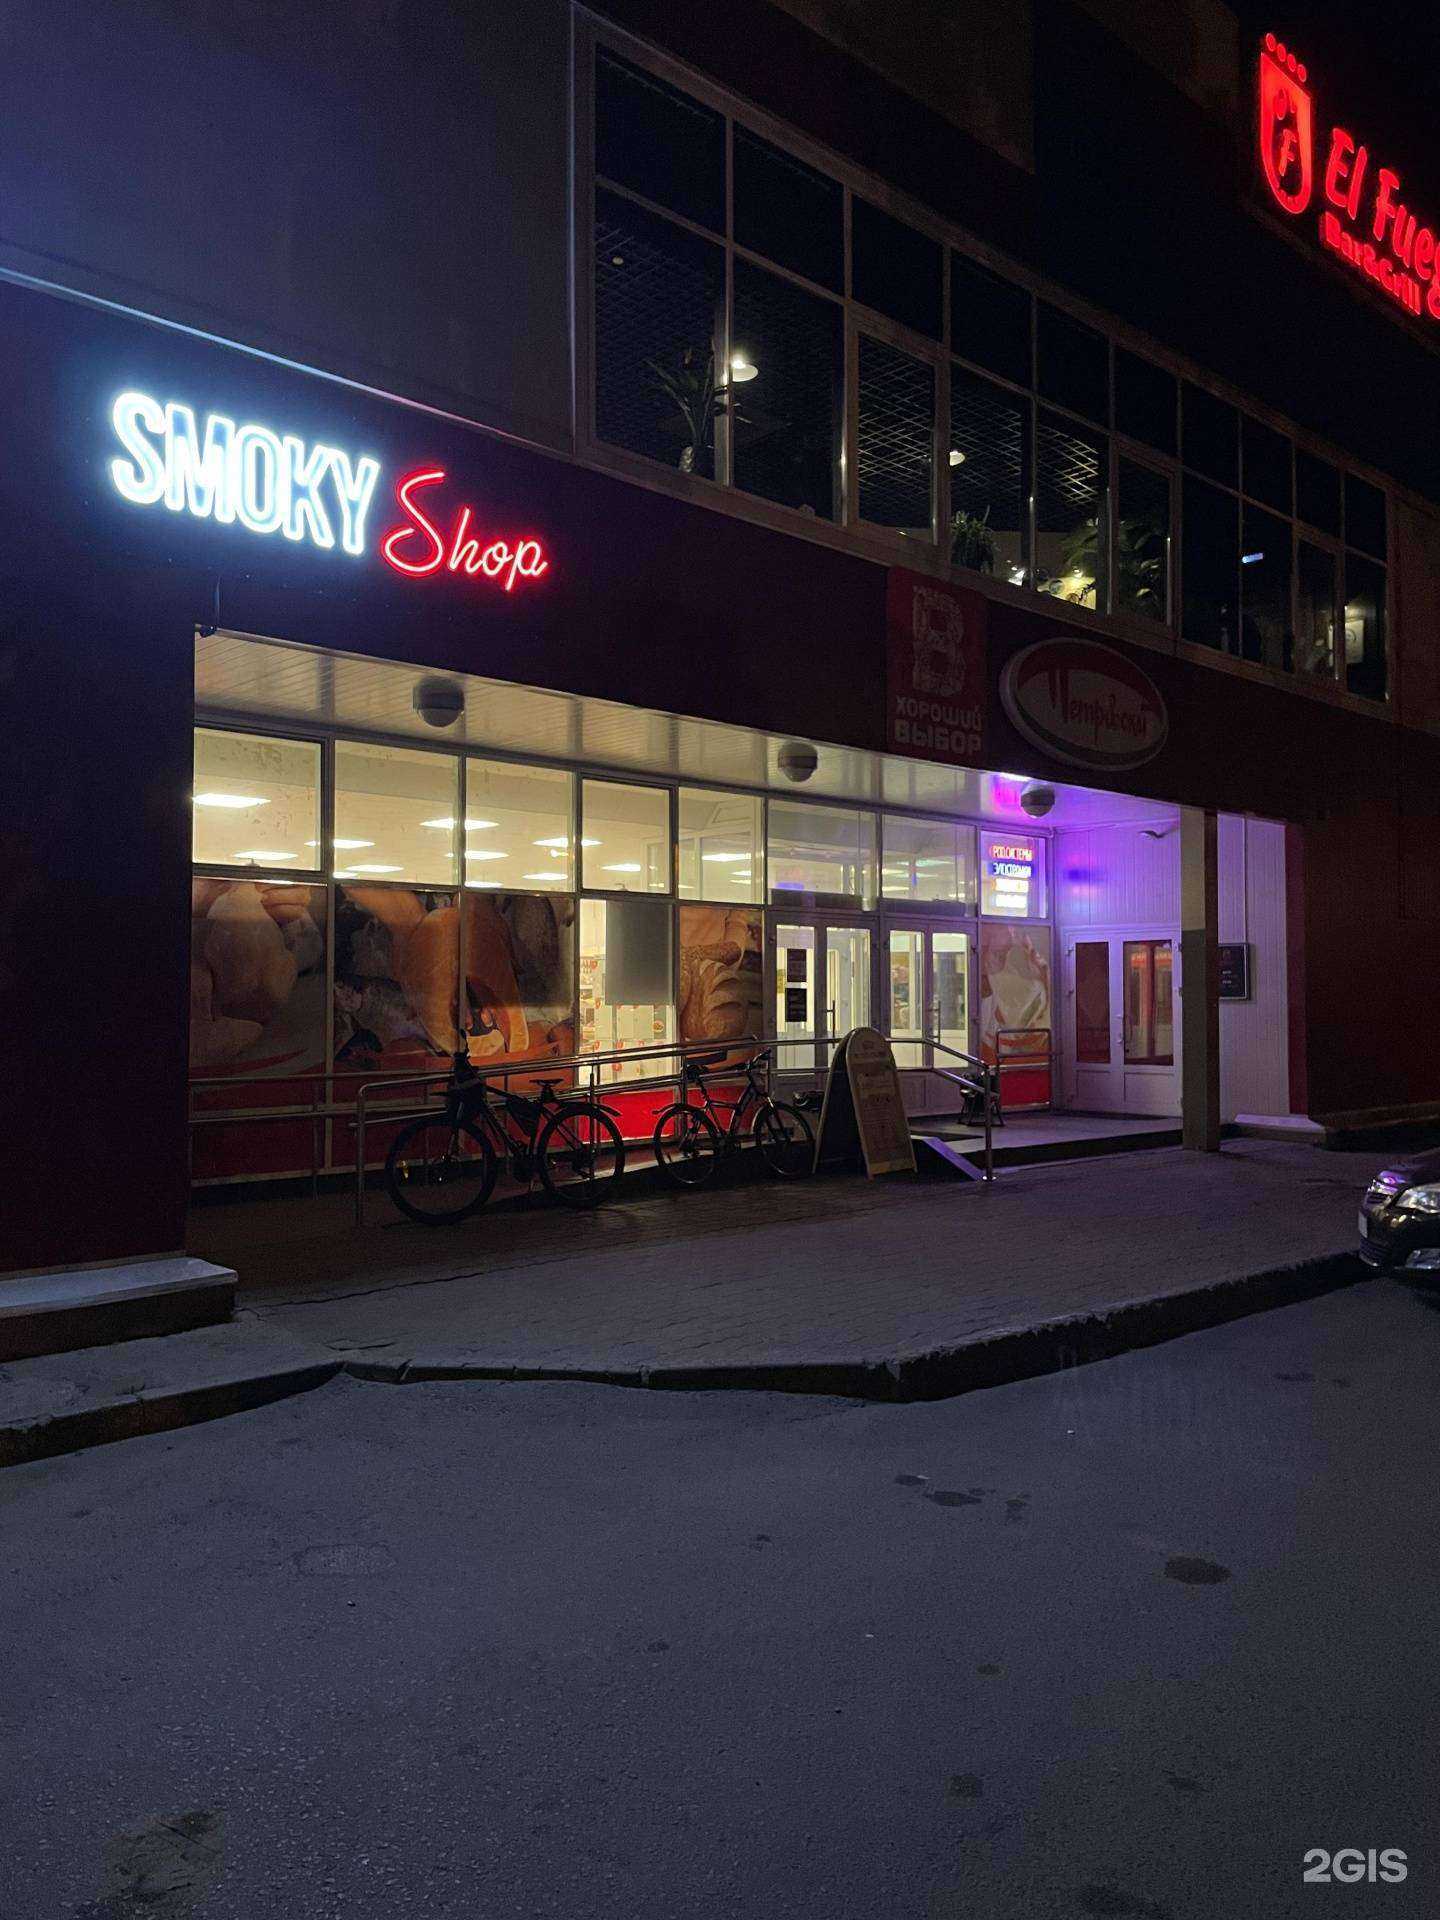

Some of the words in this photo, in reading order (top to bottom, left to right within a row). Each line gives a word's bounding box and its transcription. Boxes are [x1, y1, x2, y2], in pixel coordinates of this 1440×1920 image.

[1325, 127, 1367, 221] El
[111, 391, 381, 557] SMOKY
[384, 468, 549, 592] Shop
[894, 718, 982, 756] ВЫБОР
[895, 695, 983, 732] ХОРОШИЙ
